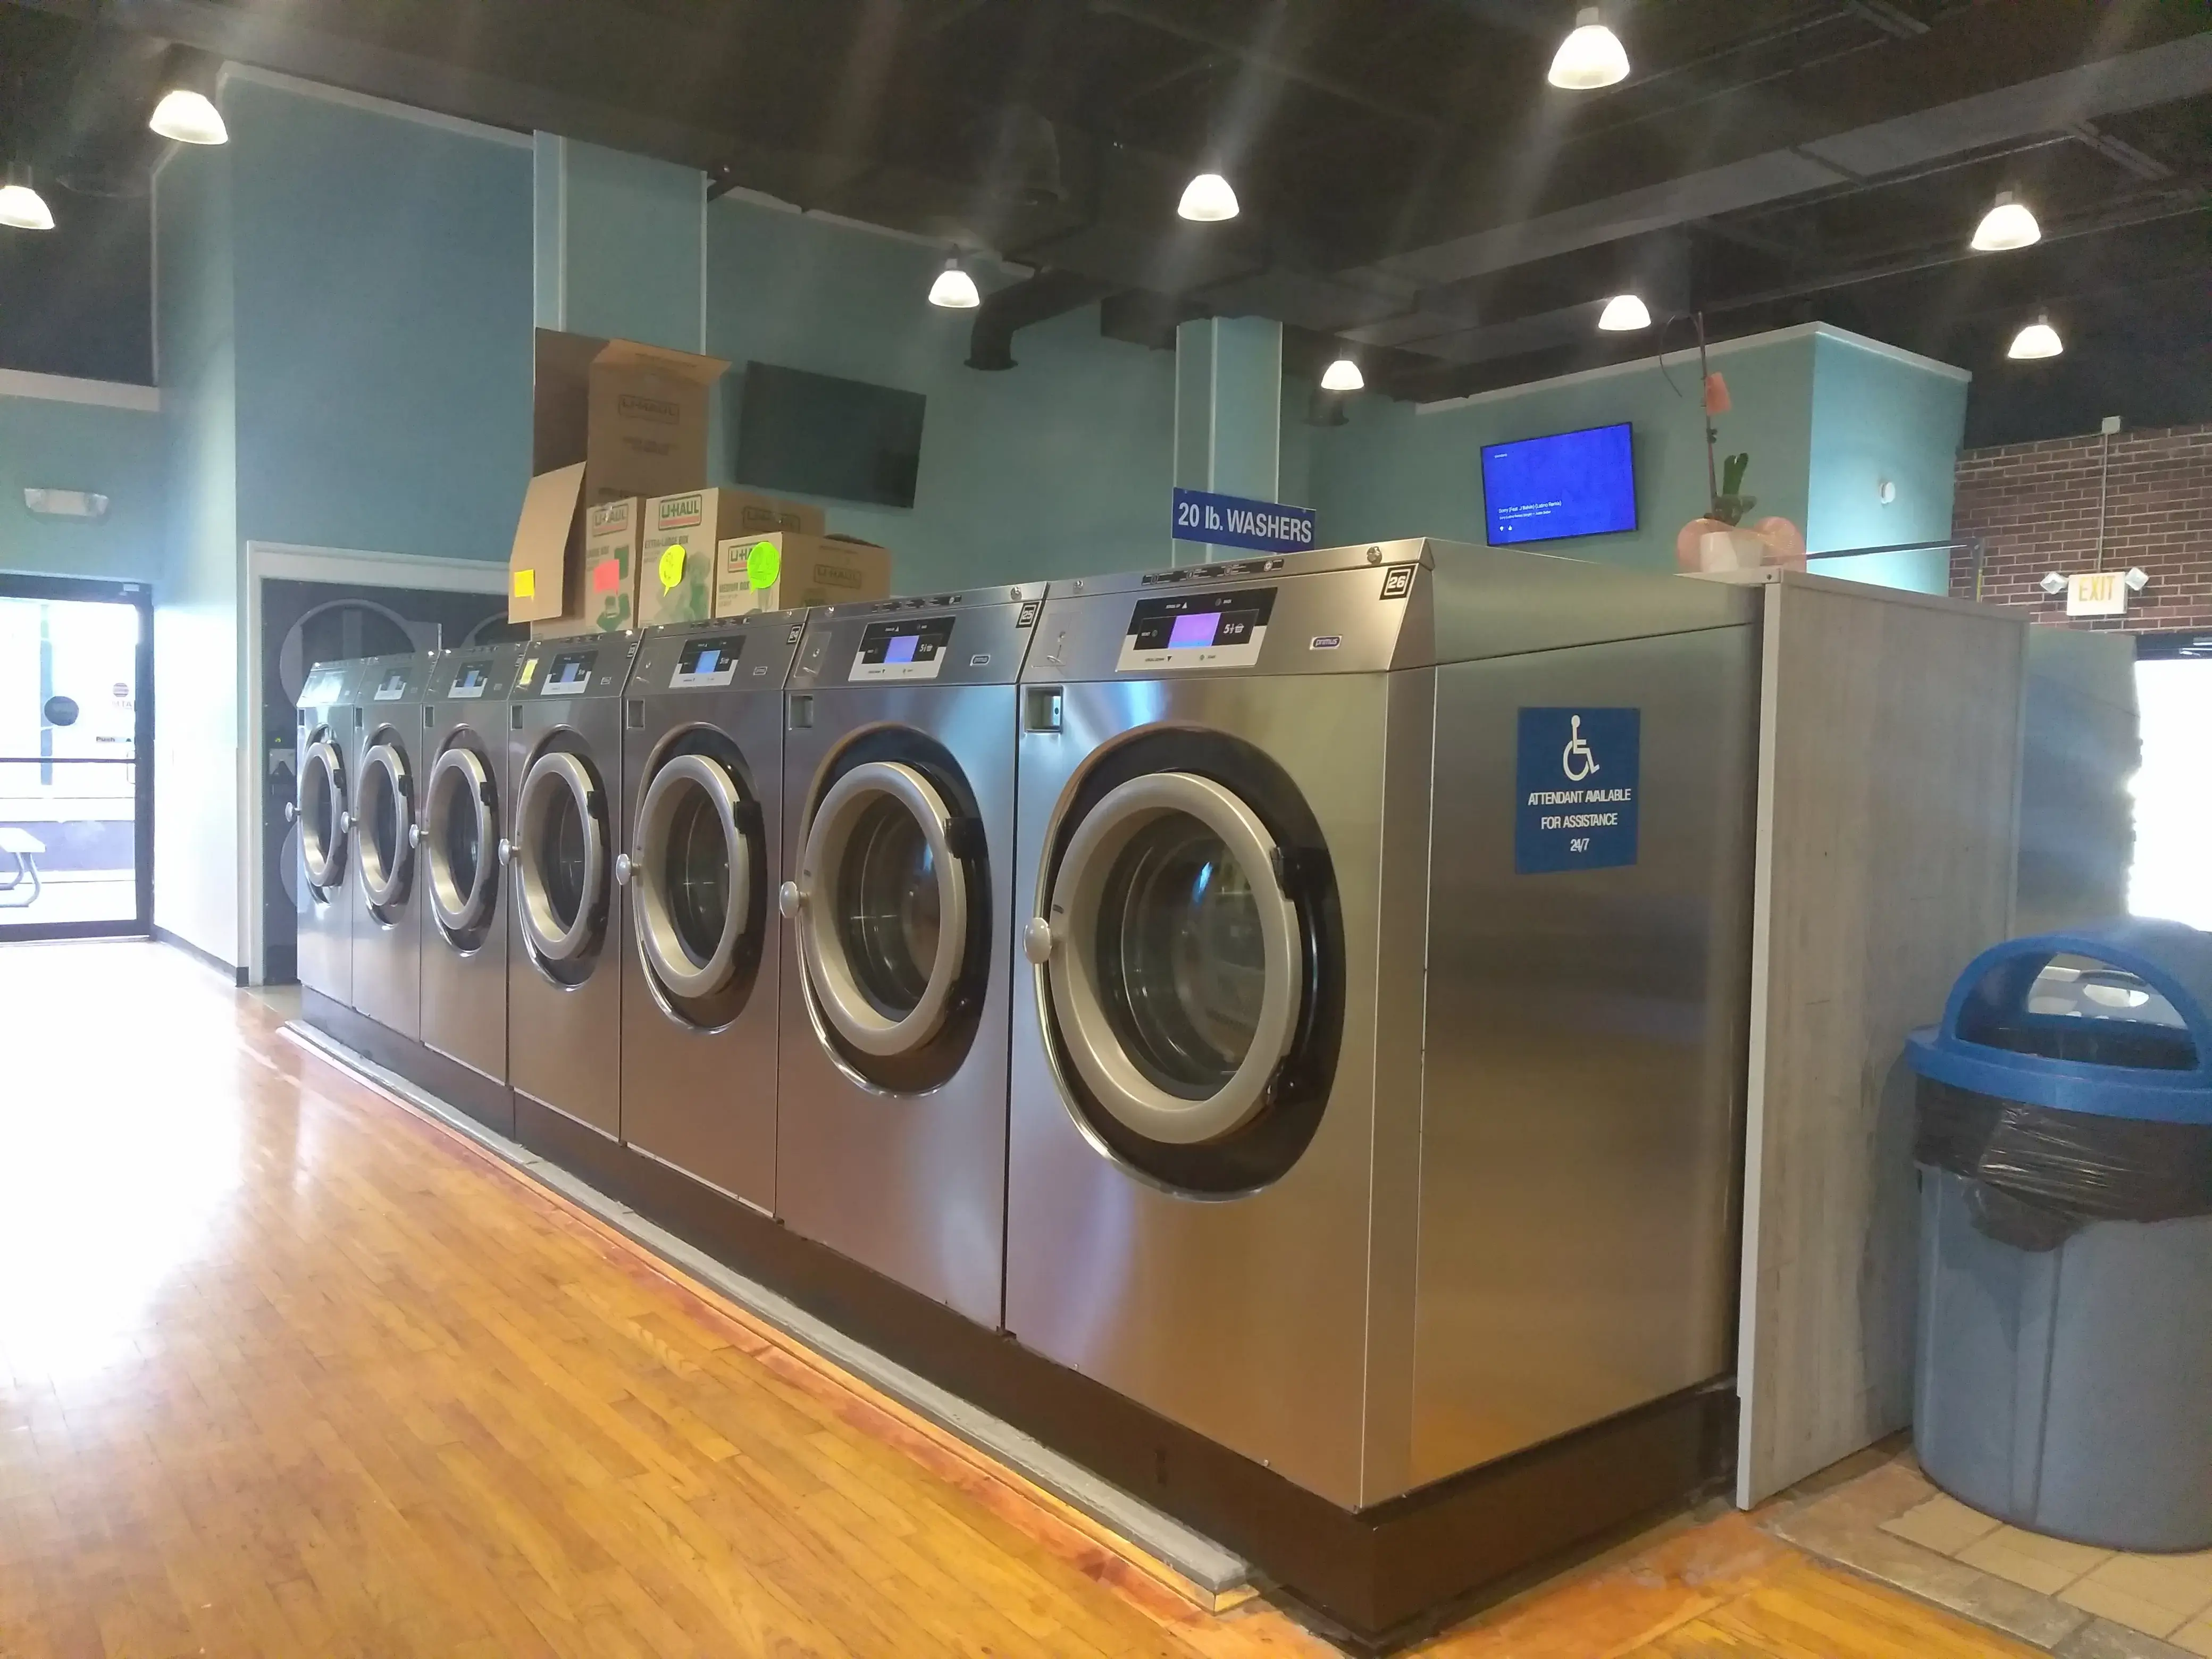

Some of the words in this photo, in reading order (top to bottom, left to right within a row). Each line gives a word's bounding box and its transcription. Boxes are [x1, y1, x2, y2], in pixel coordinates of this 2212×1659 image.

[1179, 502, 1199, 527] 20
[1205, 506, 1223, 531] lb.
[1227, 508, 1311, 543] WASHERS
[1388, 576, 1405, 589] 26
[2079, 575, 2115, 602] EXIT
[1021, 610, 1034, 620] 25
[1528, 791, 1584, 806] ATTENDANT
[1585, 789, 1631, 803] AVAILABLE
[1541, 816, 1561, 830] FOR
[1563, 813, 1618, 828] ASSISTANCE
[1570, 838, 1590, 852] 24/7
